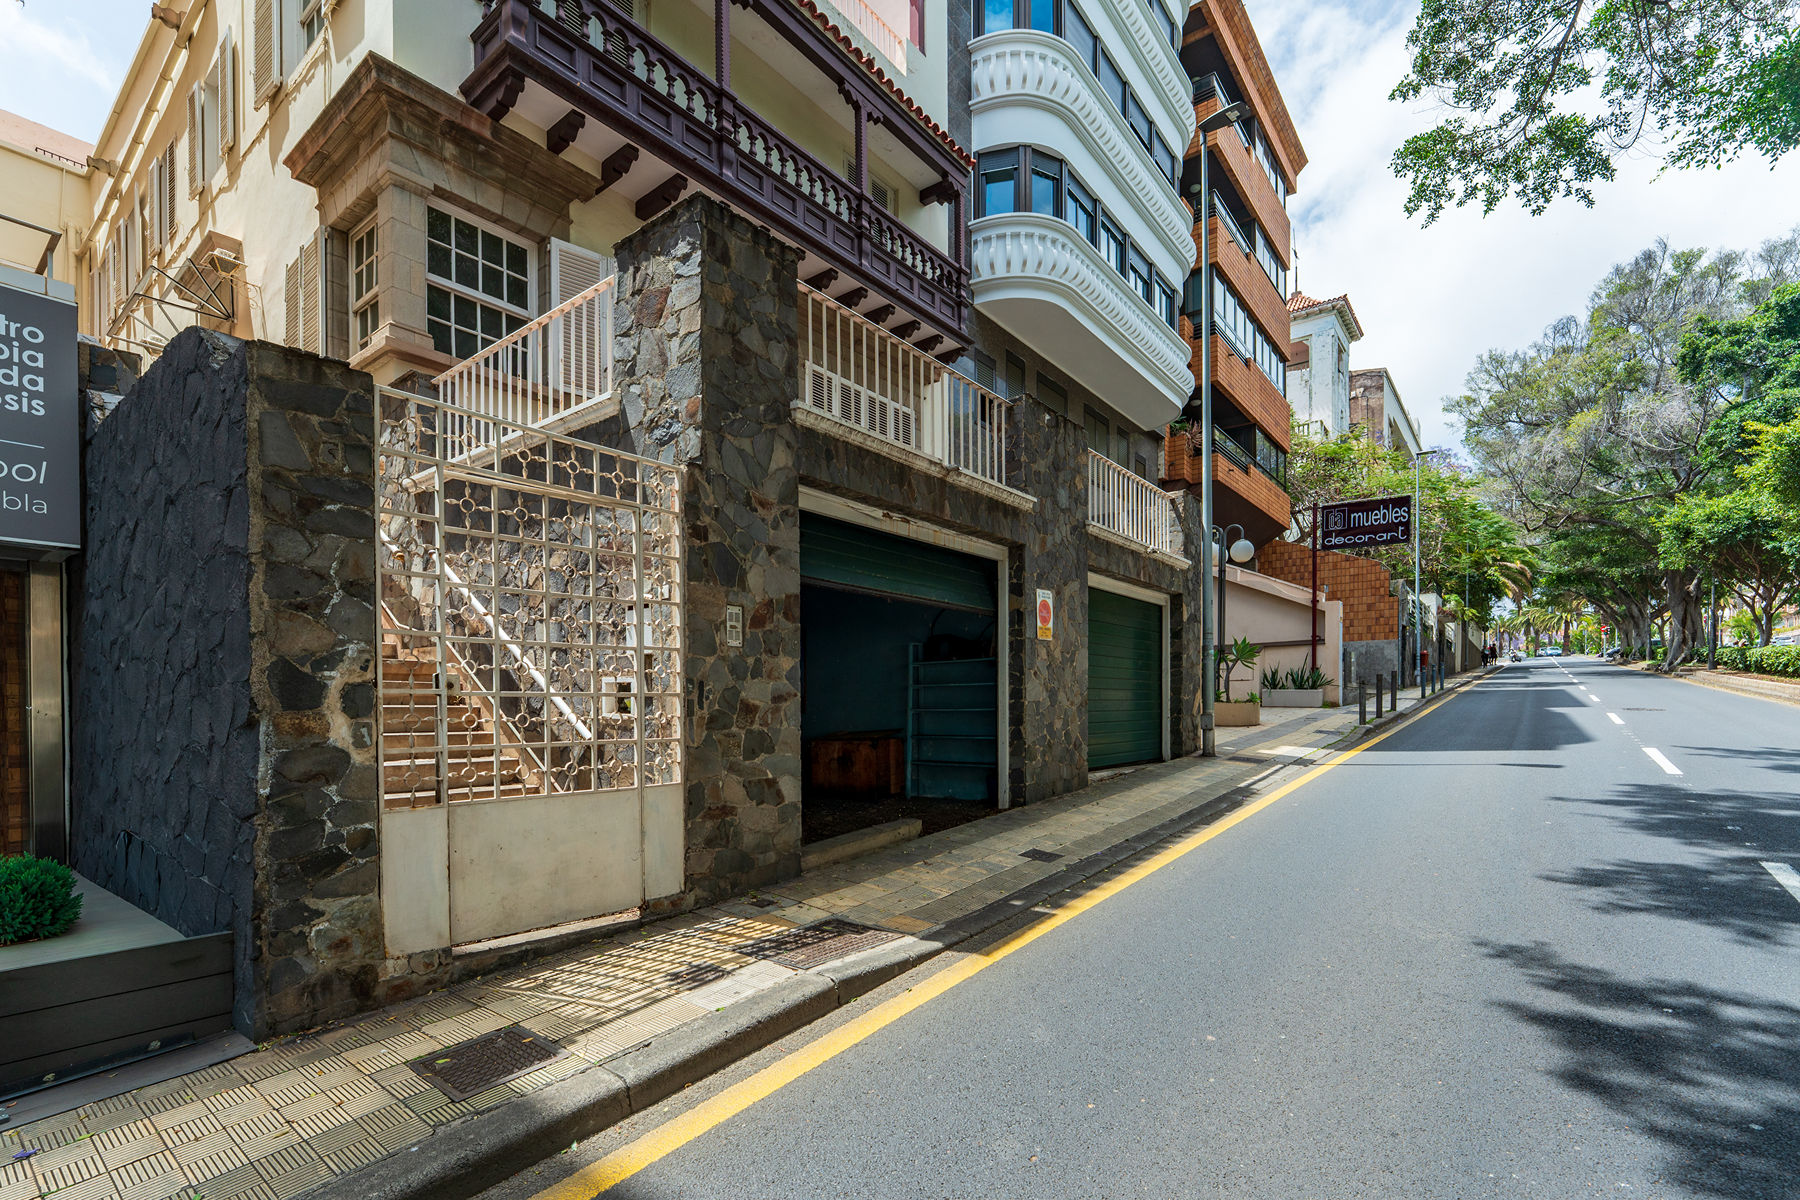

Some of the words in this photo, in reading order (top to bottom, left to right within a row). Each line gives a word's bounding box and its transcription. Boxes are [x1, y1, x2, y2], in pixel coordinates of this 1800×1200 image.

[0, 313, 45, 344] tro
[0, 365, 45, 393] da
[0, 391, 46, 416] sis
[3, 490, 47, 514] bla
[1350, 504, 1409, 528] muebles
[1324, 526, 1408, 546] decorart
